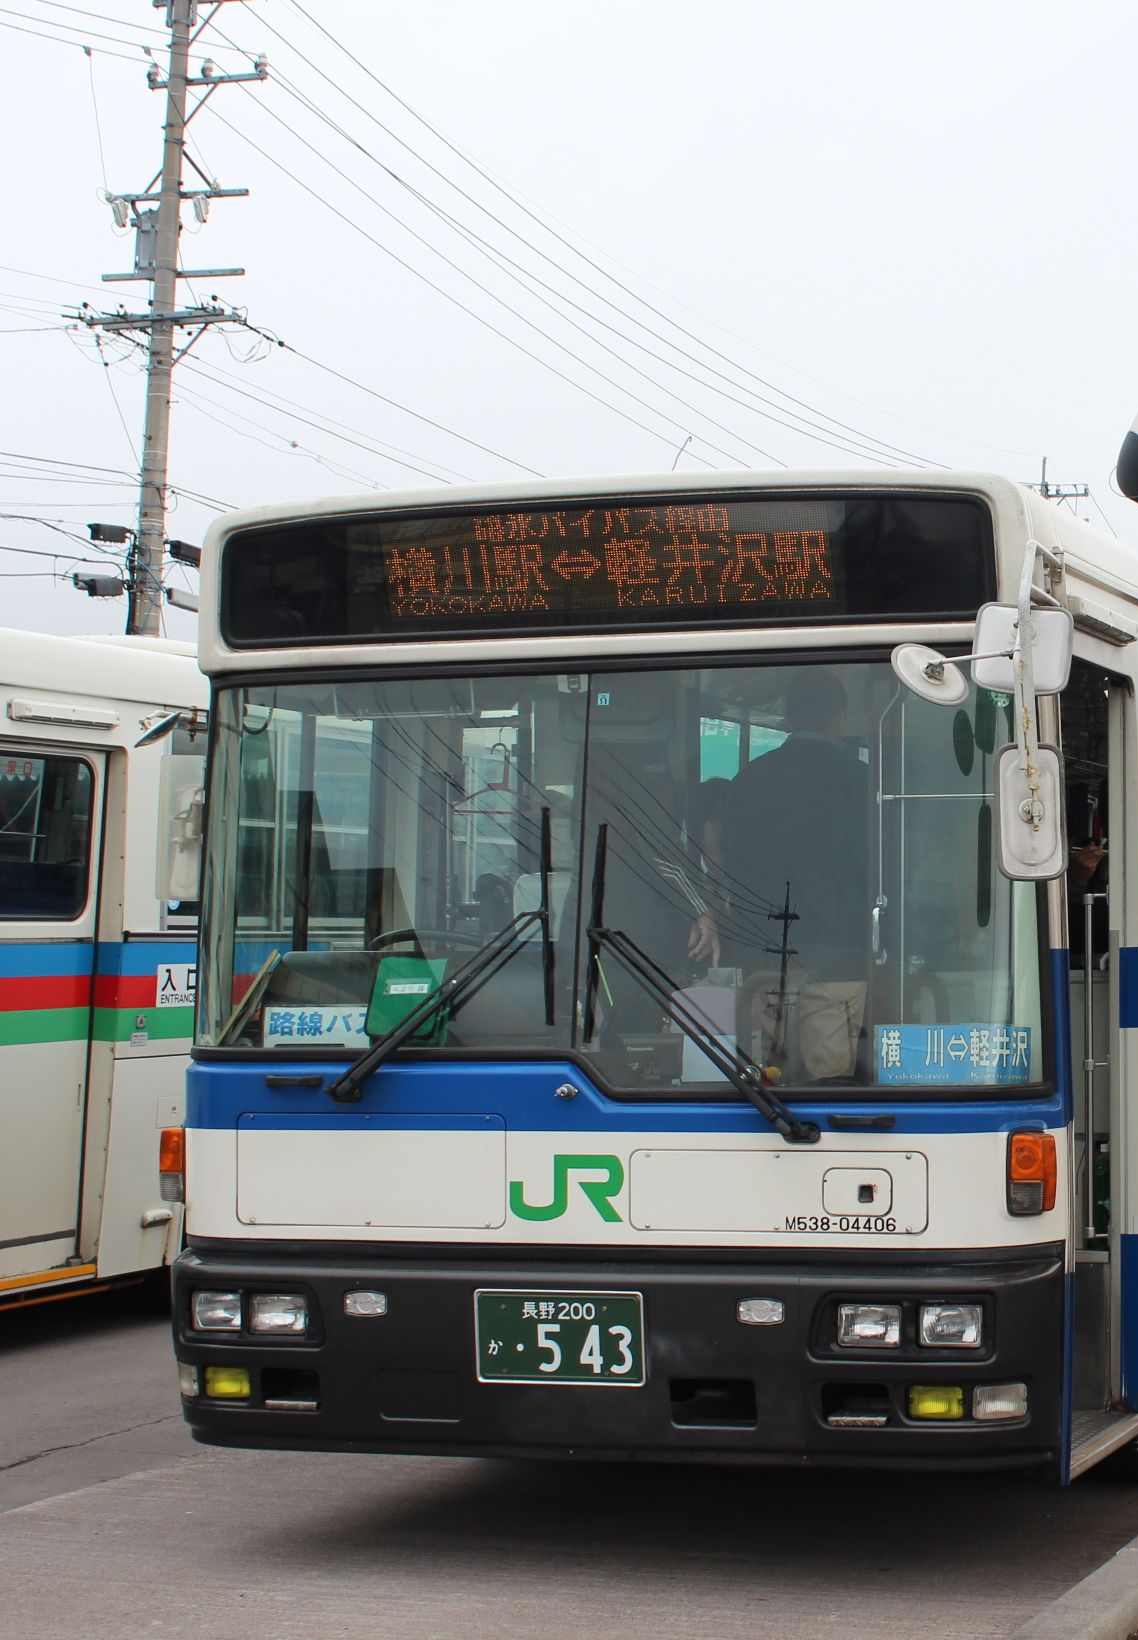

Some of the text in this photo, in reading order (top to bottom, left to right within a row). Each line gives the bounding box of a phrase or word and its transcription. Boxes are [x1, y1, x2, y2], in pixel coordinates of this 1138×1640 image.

[392, 594, 549, 616] YOKOKAWA
[969, 1028, 1028, 1068] 軽井沢
[509, 1153, 625, 1223] JR
[784, 1216, 897, 1232] M538-04406
[488, 1338, 504, 1356] か
